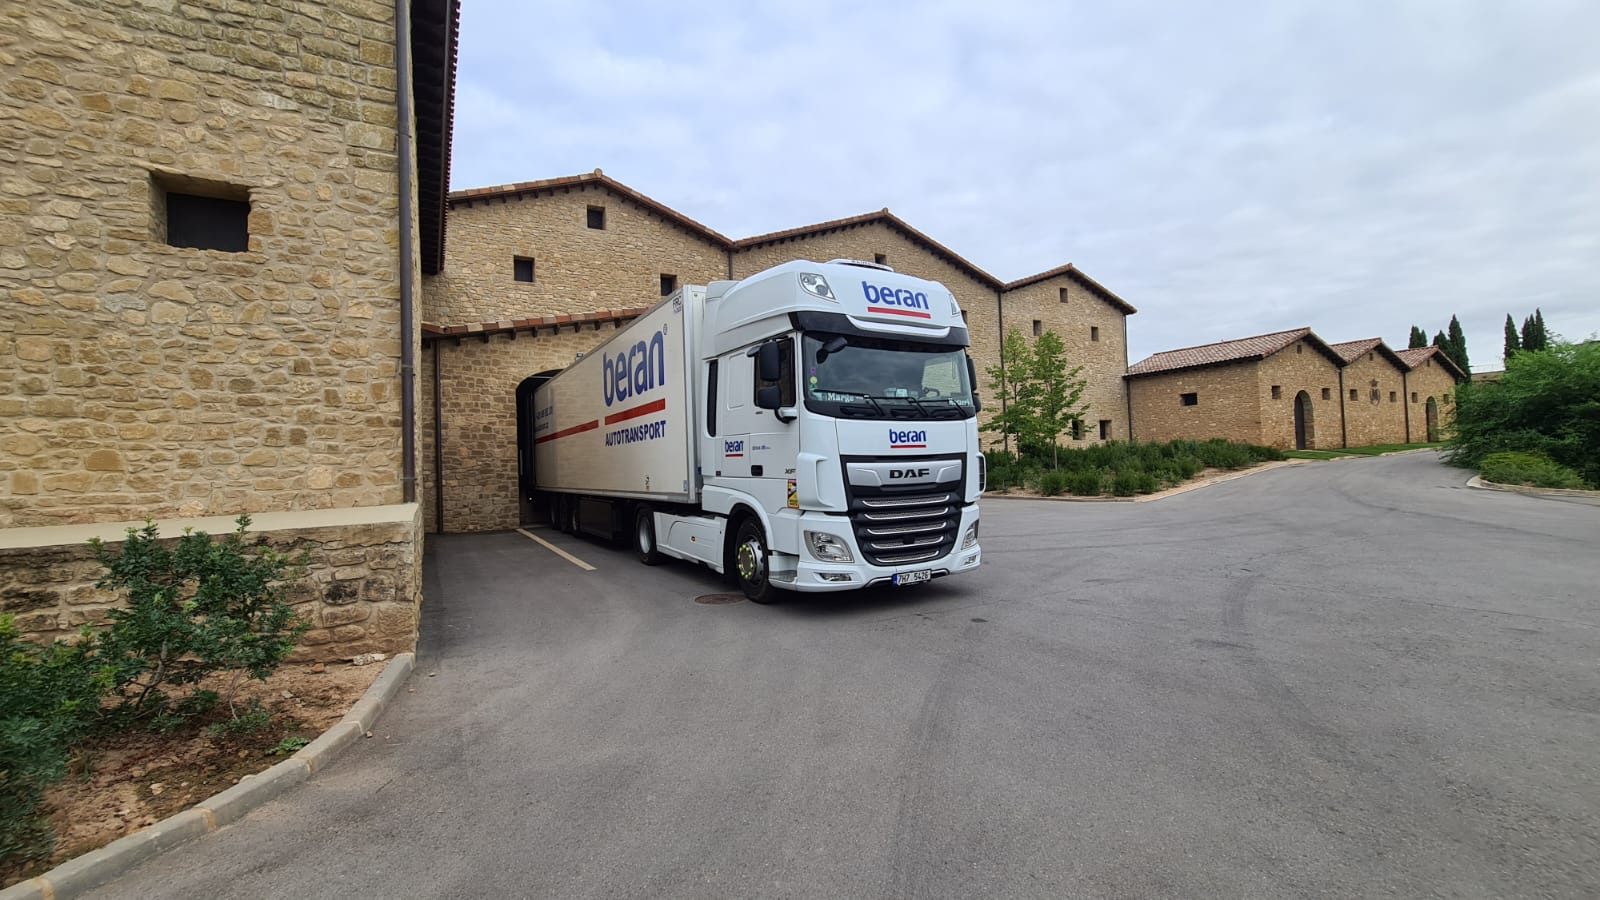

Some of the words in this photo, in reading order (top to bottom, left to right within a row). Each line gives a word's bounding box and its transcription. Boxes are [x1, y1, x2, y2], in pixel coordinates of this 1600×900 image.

[862, 281, 929, 310] beran
[603, 330, 665, 407] beran
[605, 420, 667, 447] AUTOTRANSPORT
[889, 429, 927, 444] beran
[724, 440, 744, 453] beran
[889, 468, 930, 479] DAF
[898, 574, 910, 583] 7H7
[914, 571, 929, 580] 5426
